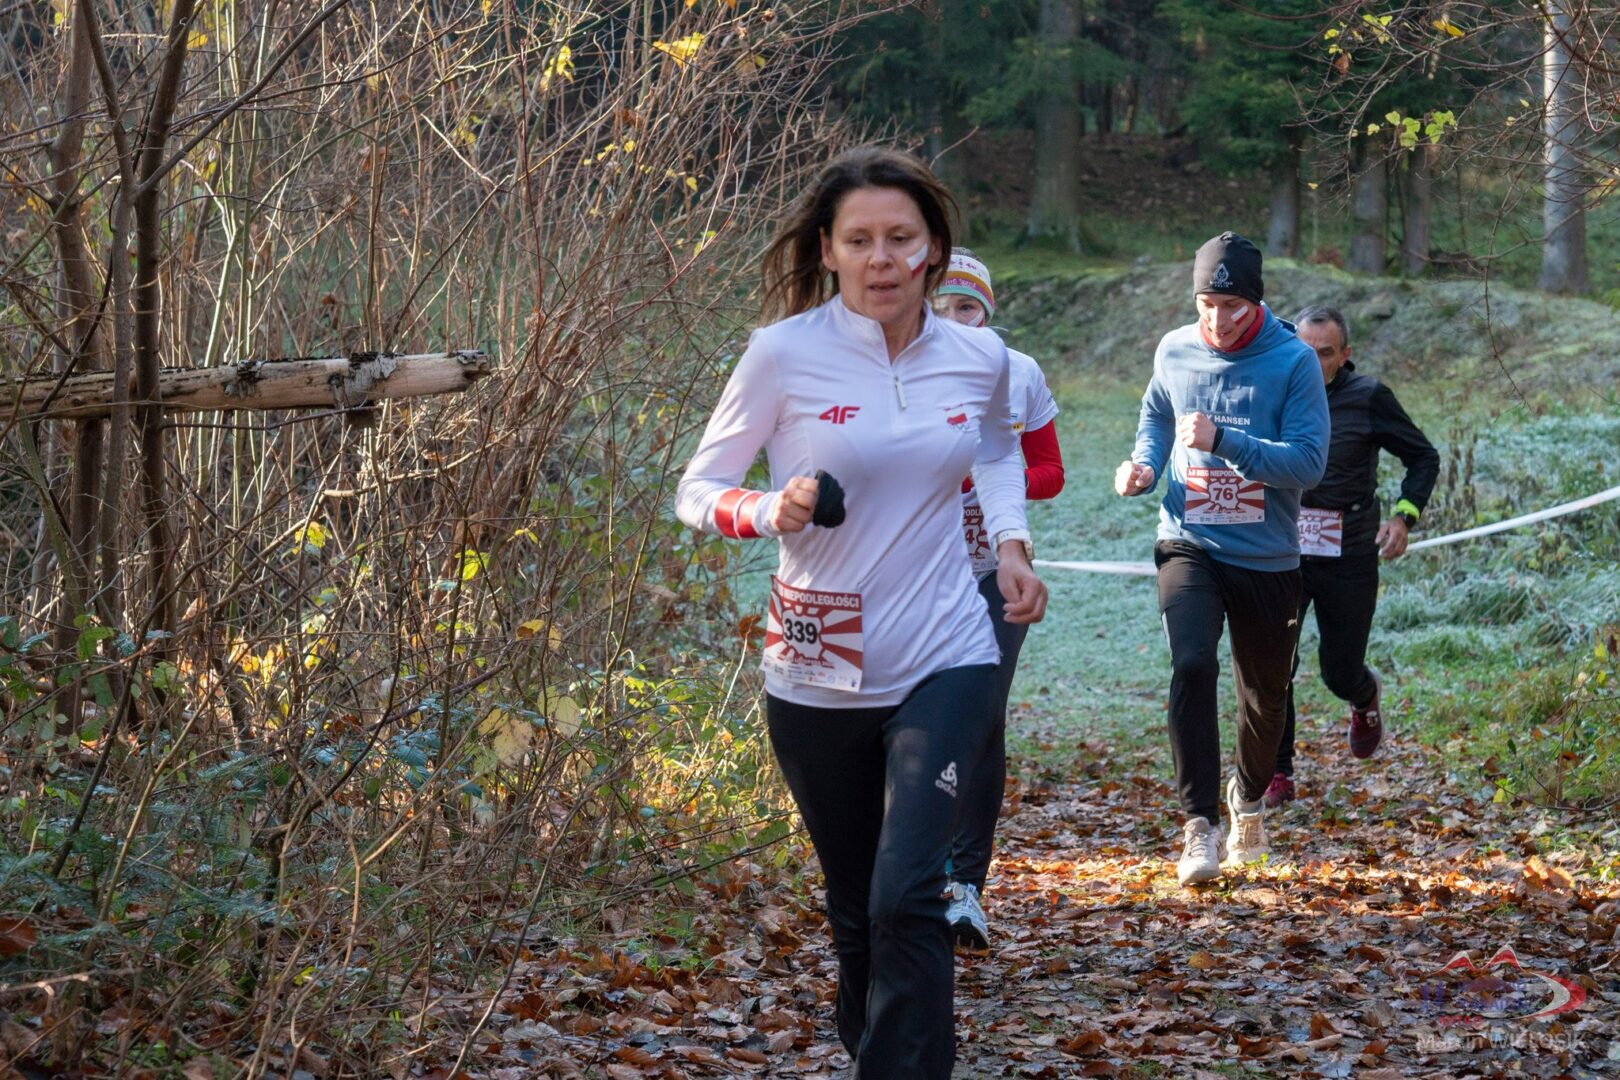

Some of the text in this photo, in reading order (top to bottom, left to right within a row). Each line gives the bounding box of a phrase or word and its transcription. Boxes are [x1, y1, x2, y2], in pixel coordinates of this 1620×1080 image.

[818, 405, 862, 425] 4F
[1214, 415, 1251, 426] HANSEN
[1213, 488, 1234, 501] 76
[1299, 524, 1319, 535] 145
[784, 618, 818, 644] 339
